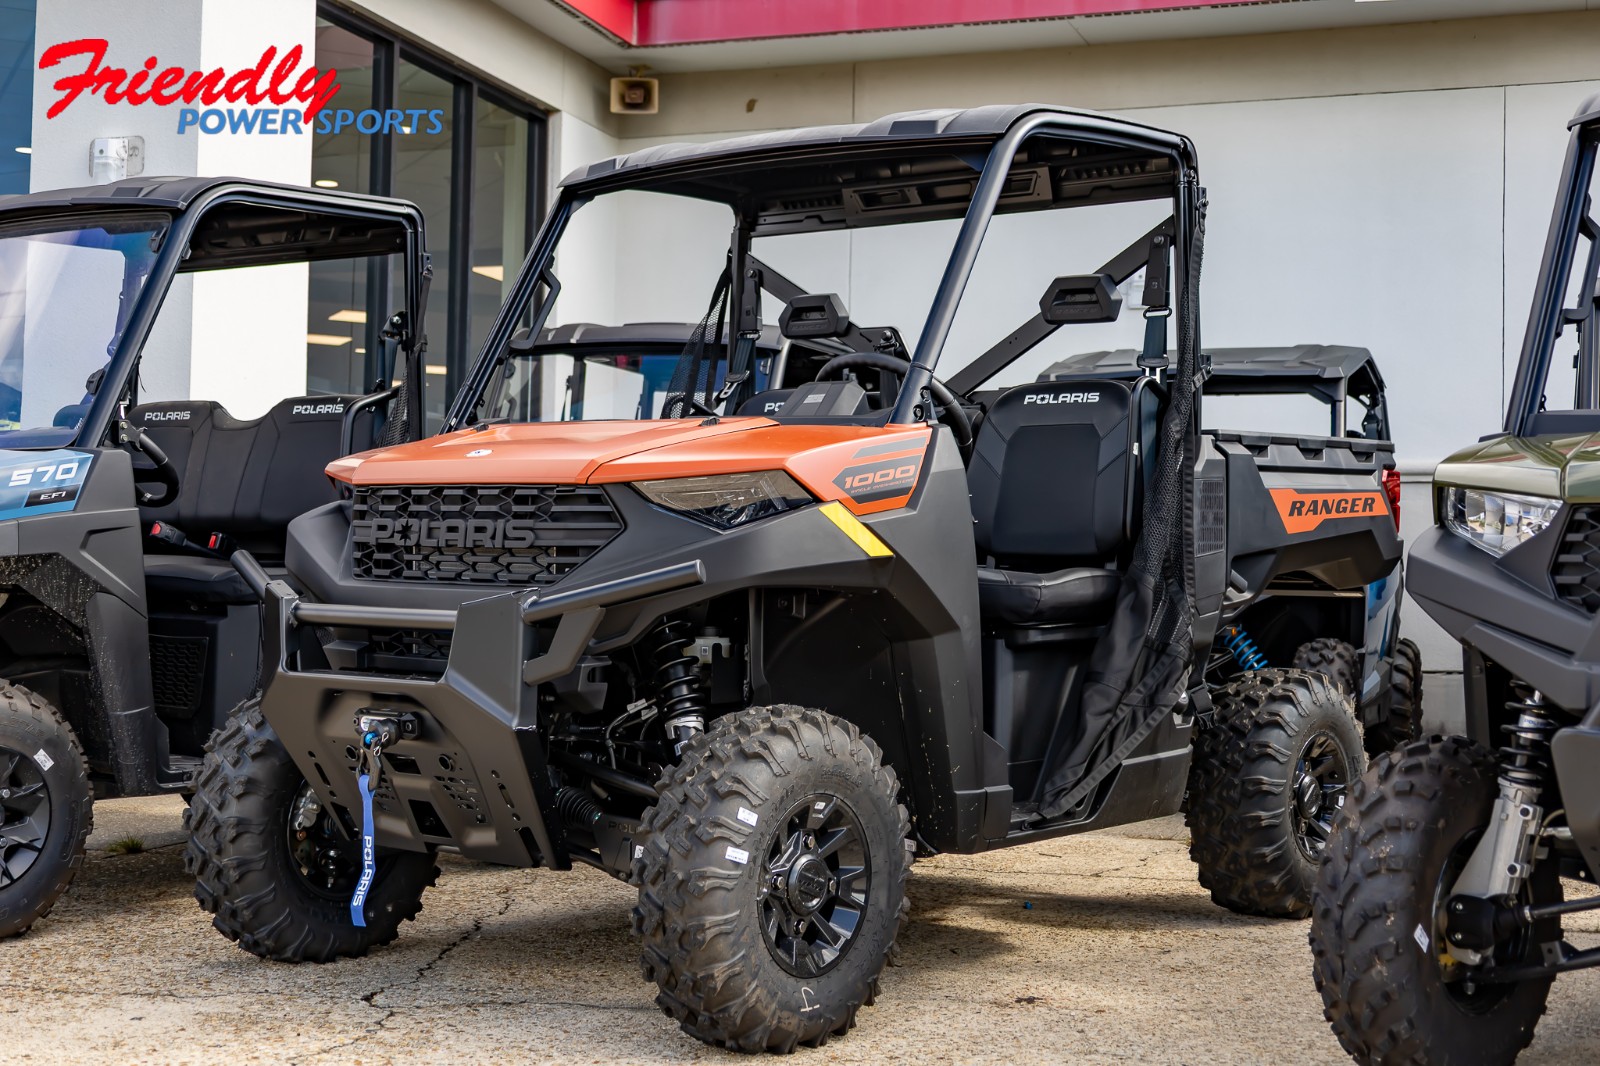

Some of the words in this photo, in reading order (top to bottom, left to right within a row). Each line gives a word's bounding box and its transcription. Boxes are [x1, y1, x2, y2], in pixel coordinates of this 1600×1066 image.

[1023, 392, 1100, 405] POLARIS
[144, 411, 191, 421] POLARIS
[292, 404, 344, 414] POLARIS
[8, 463, 79, 487] 570
[844, 465, 916, 489] 1000
[40, 491, 67, 500] EFI
[1288, 497, 1376, 517] RANGER
[370, 518, 536, 548] POLARIS
[352, 835, 373, 907] POLARIS
